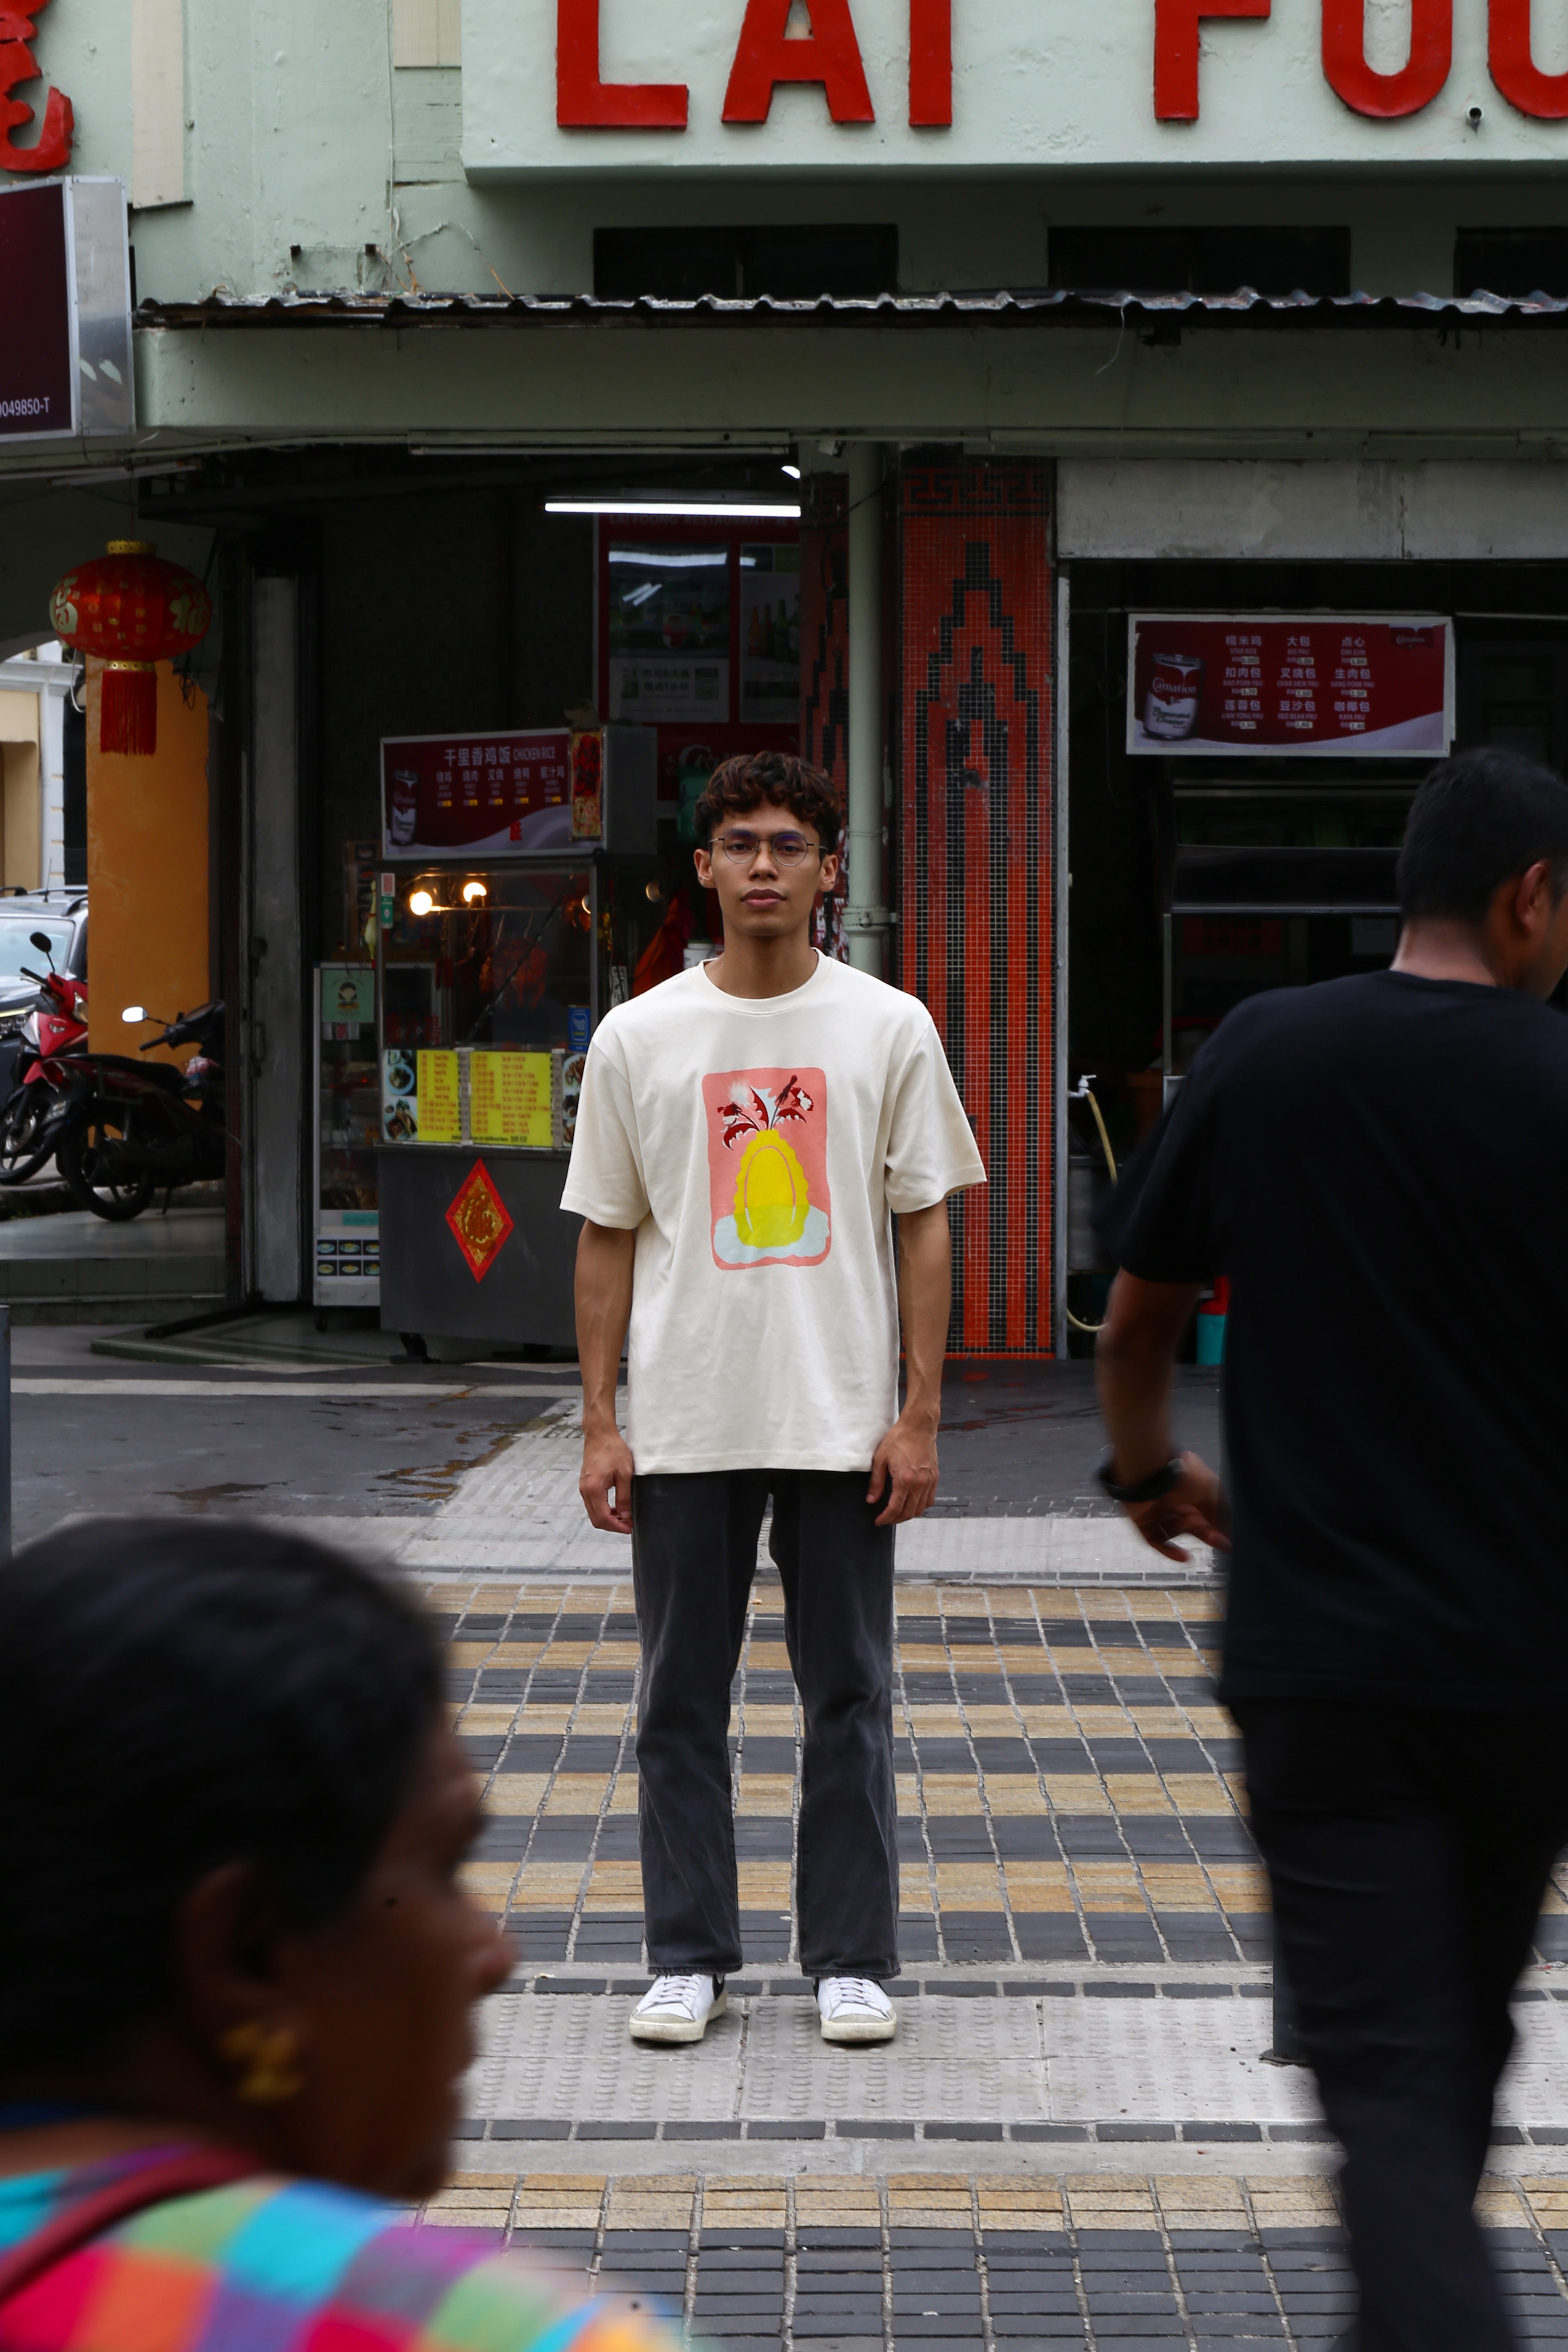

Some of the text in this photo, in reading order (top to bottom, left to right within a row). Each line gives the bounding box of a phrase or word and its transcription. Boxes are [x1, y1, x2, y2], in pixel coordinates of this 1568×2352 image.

[0, 397, 50, 418] 049850-T
[1286, 636, 1310, 647] 大包
[1341, 636, 1365, 648] 点心
[1225, 667, 1261, 678] 扣肉包
[1280, 667, 1317, 679] 叉烧包
[1335, 668, 1371, 679] 生肉包
[1152, 676, 1197, 694] Carnation
[1279, 700, 1315, 711] 豆沙包
[513, 747, 540, 761] CHICKEN
[541, 746, 556, 759] RICE
